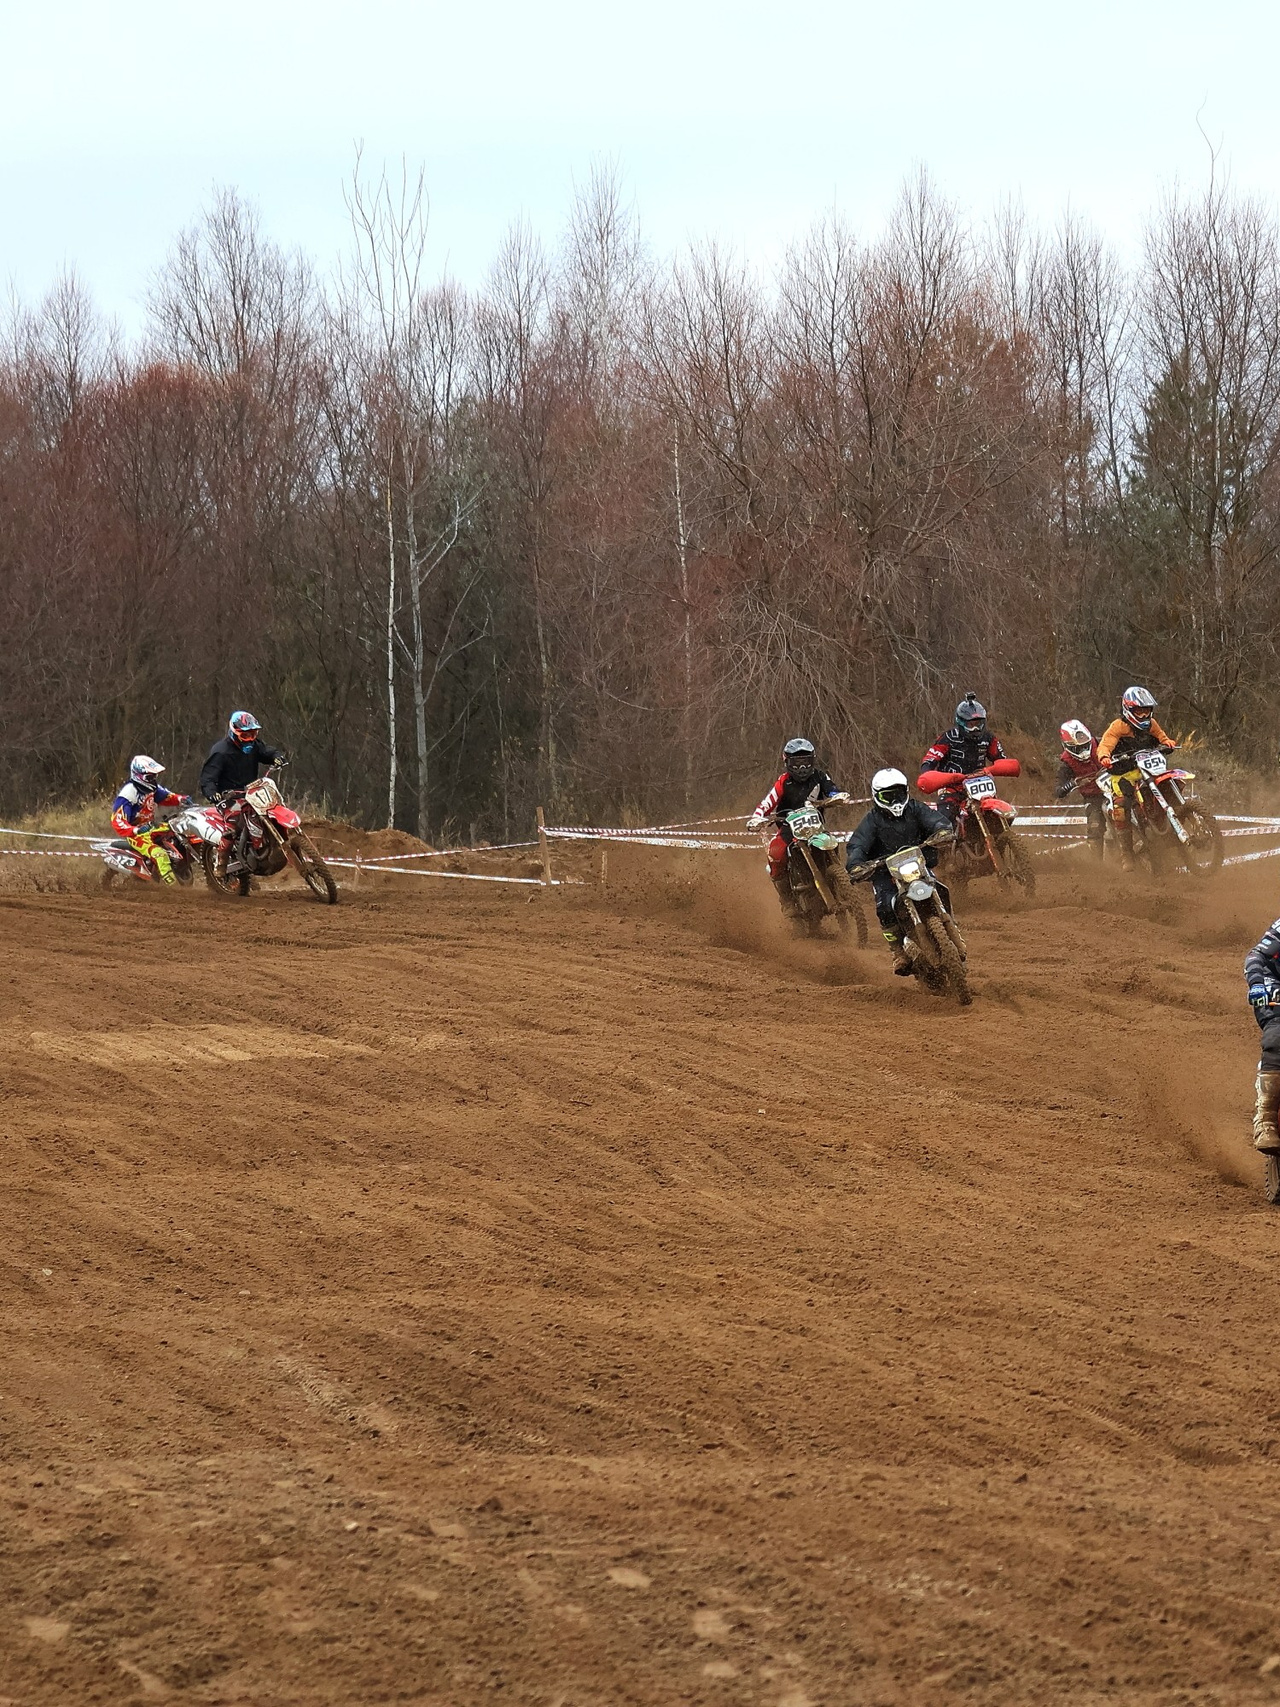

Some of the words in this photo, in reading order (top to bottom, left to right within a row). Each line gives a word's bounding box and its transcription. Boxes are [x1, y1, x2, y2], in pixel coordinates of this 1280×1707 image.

[1143, 757, 1166, 769] 654
[970, 782, 994, 795] 800
[793, 815, 820, 831] 548
